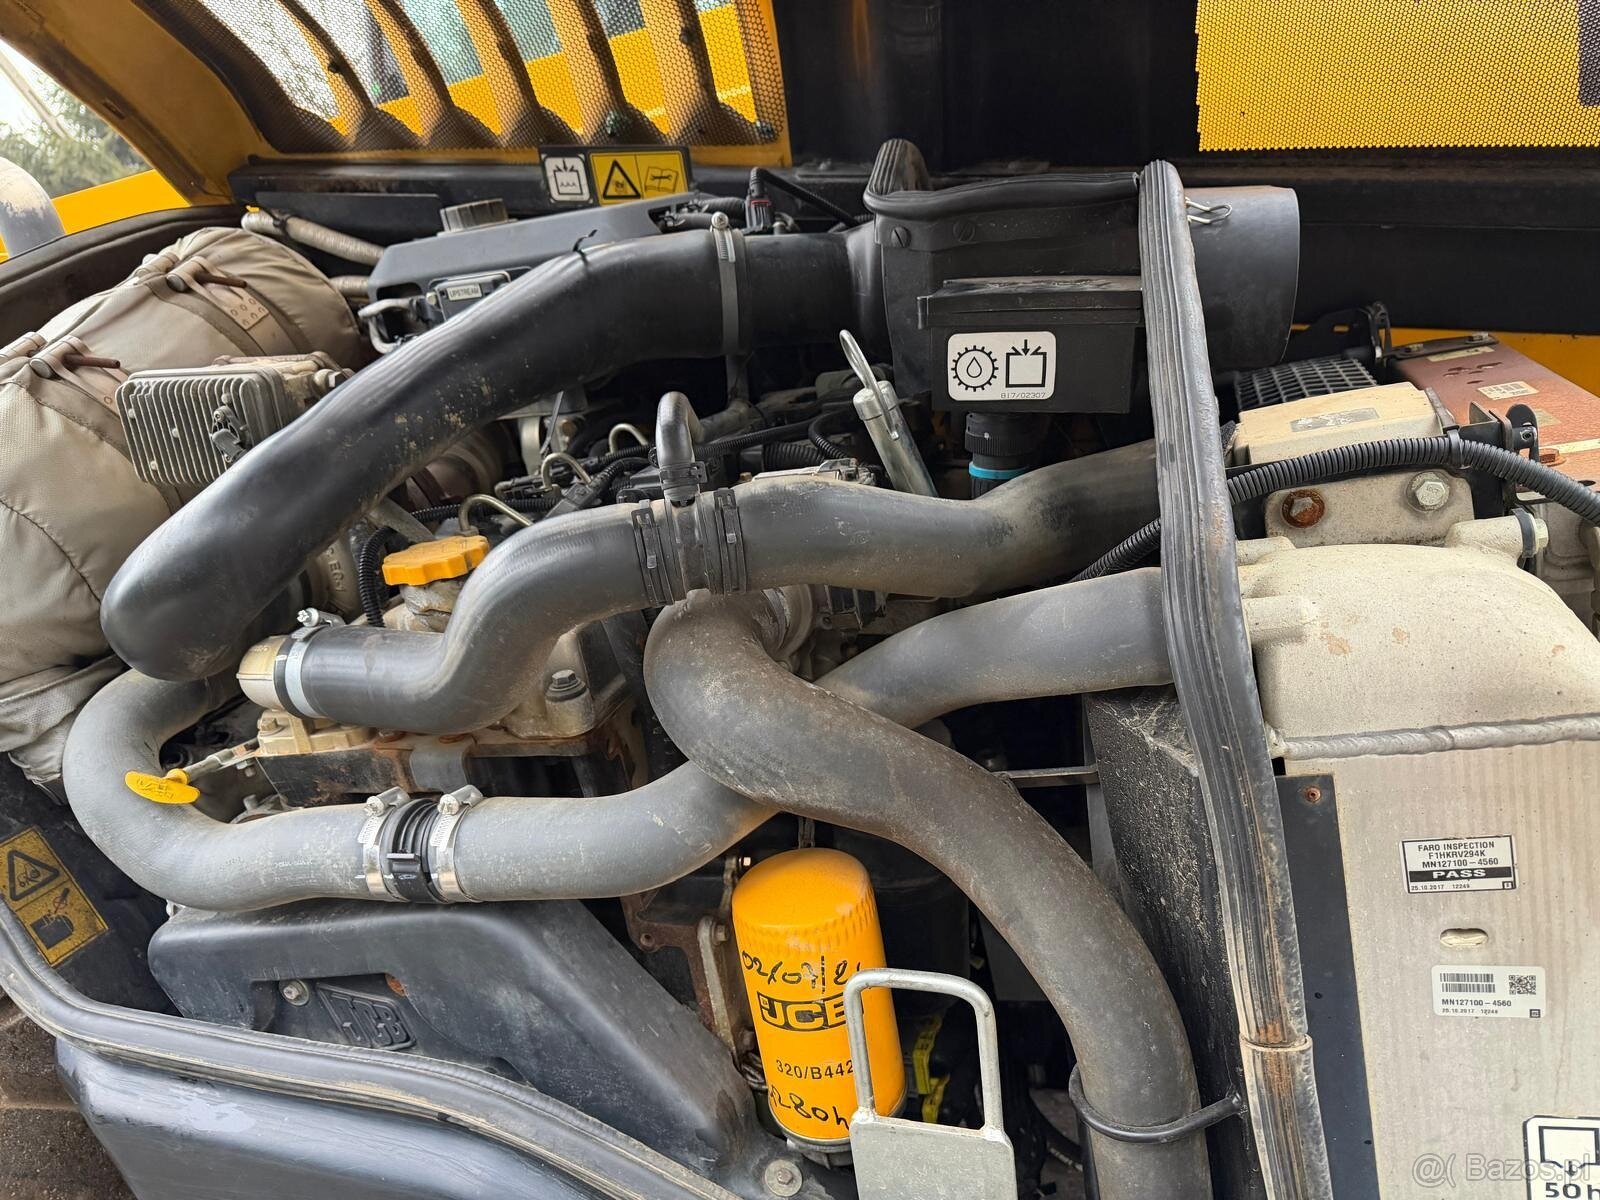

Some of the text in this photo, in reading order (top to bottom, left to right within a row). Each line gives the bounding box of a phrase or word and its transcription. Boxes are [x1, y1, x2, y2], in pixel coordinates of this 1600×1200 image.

[1418, 841, 1495, 852] FARO INSPECTION
[1432, 869, 1486, 879] PASS
[775, 1059, 854, 1080] 320/B442
[1545, 1182, 1582, 1199] 50
